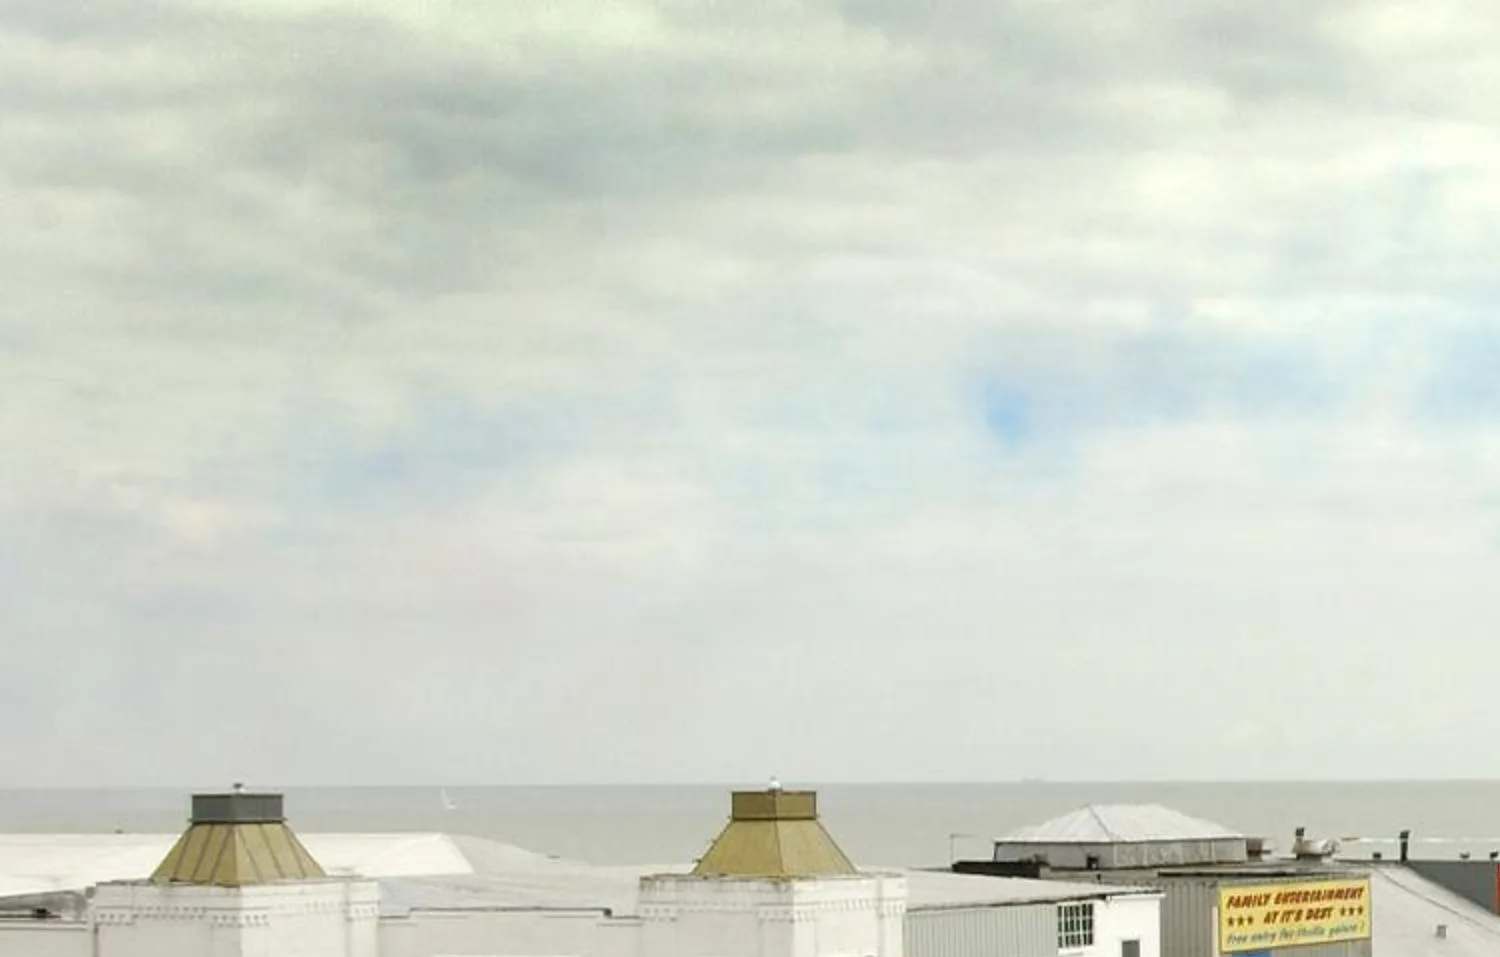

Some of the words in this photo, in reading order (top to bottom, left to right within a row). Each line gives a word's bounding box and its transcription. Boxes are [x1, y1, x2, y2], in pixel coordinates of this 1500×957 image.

[1226, 893, 1271, 909] FAMILY
[1274, 887, 1365, 905] ENTERTAINMENT
[1263, 911, 1278, 925] AT
[1280, 909, 1303, 924] IT'S
[1305, 906, 1334, 921] BEST
[1227, 933, 1247, 944] Free
[1251, 930, 1277, 945] entry
